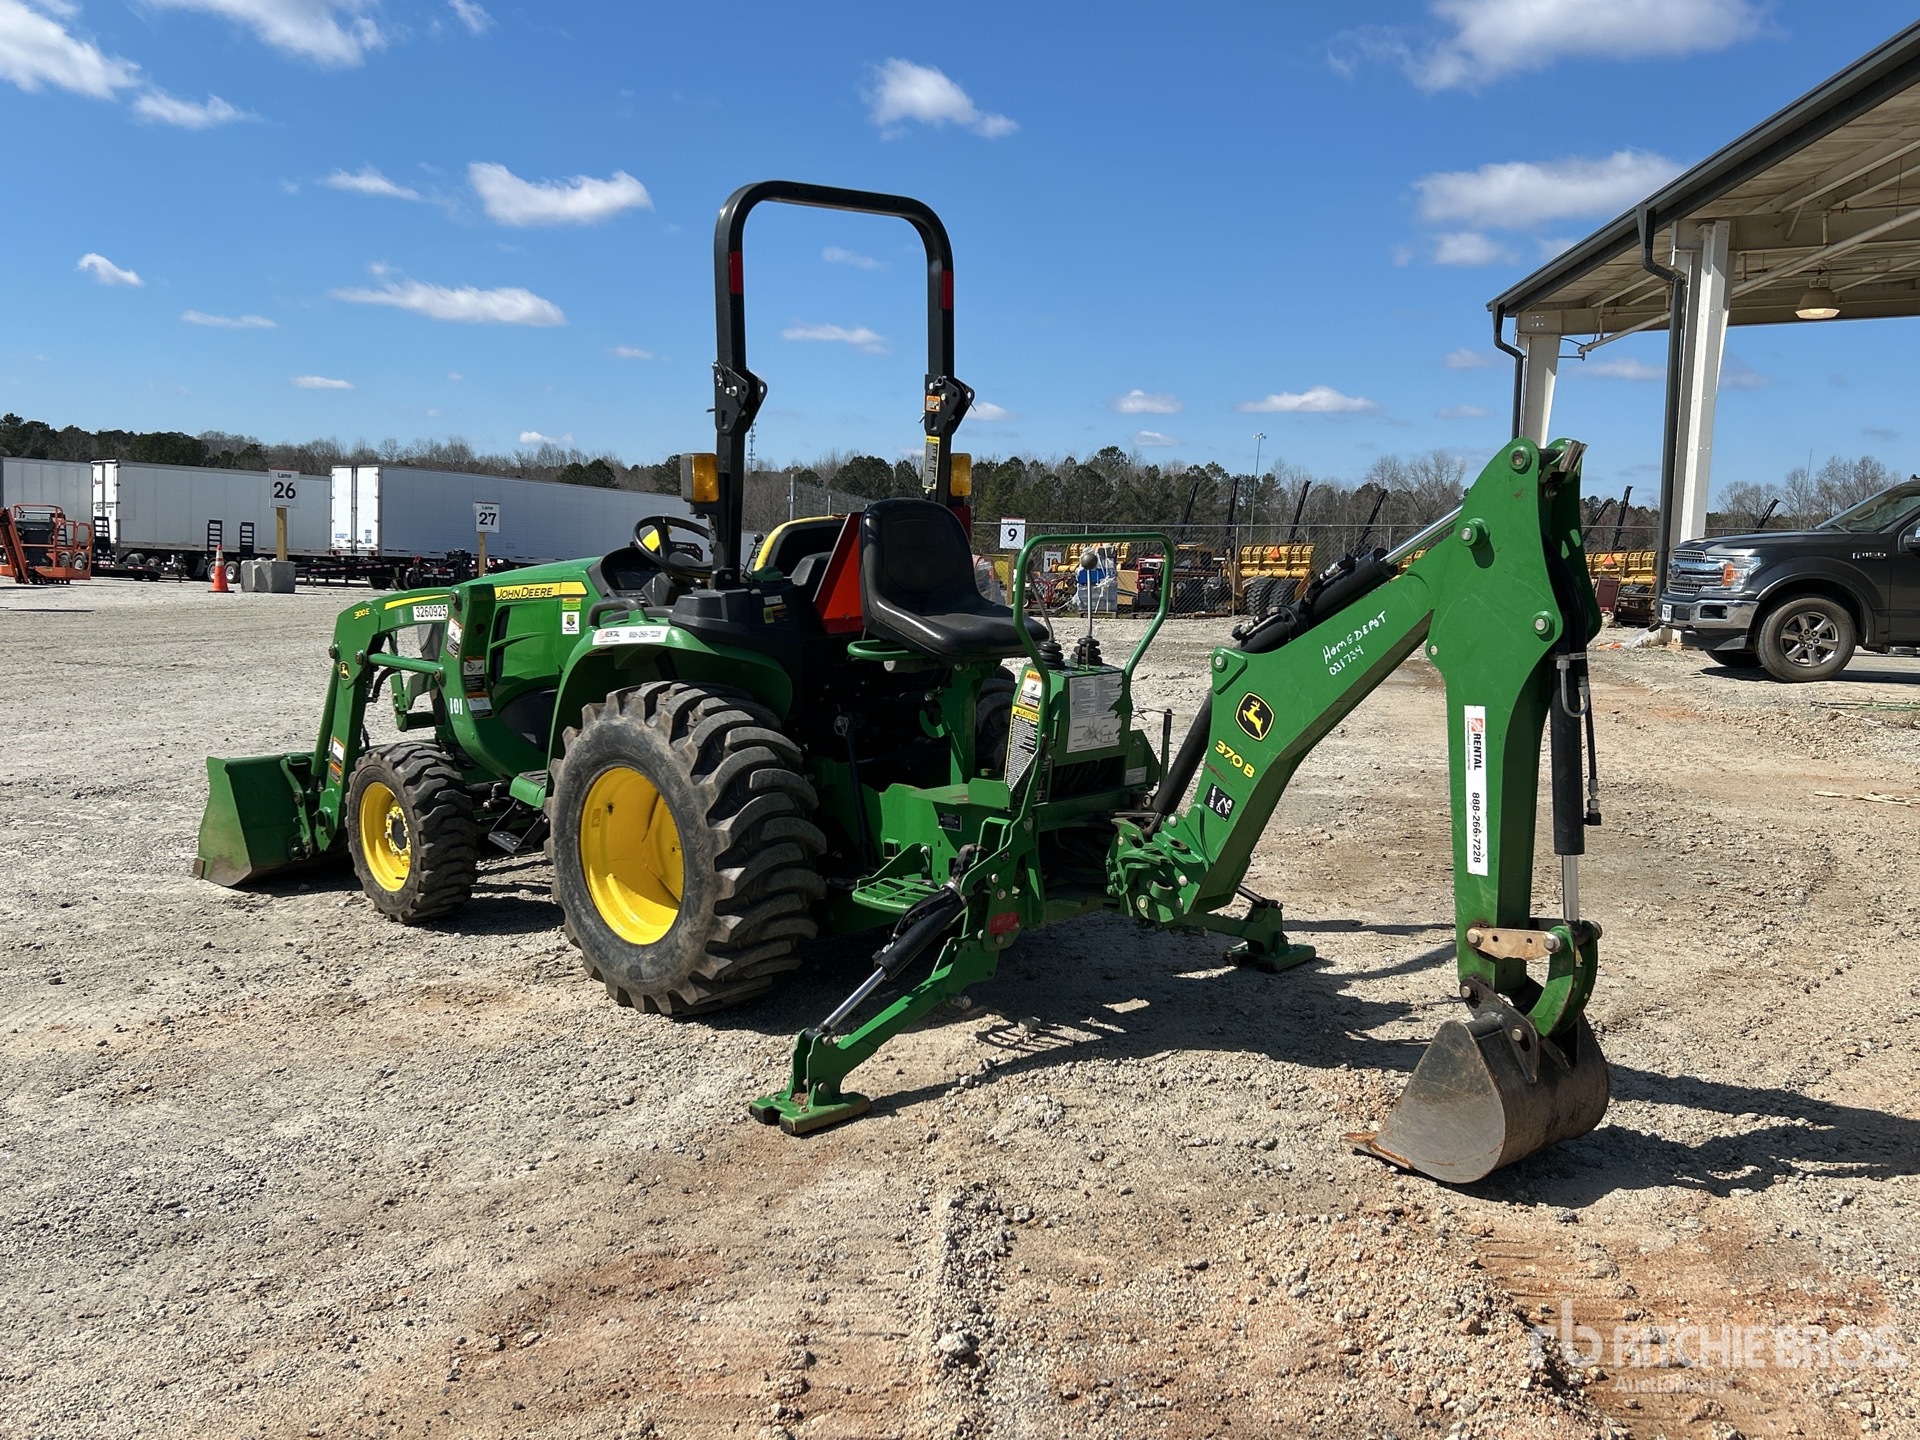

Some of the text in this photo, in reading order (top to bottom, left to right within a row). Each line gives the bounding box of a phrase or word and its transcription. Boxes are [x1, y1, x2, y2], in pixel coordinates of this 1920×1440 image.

[273, 481, 296, 500] 26
[478, 512, 497, 526] 27
[1008, 528, 1018, 542] 9
[495, 585, 554, 599] JOHN DEERE
[353, 608, 371, 620] 300E
[415, 605, 448, 618] 3260925
[1353, 610, 1386, 641] DEPOT
[1329, 645, 1364, 675] 031734
[449, 697, 464, 715] 101
[1214, 740, 1256, 779] 370 B
[1473, 733, 1483, 771] RENTAL
[1471, 792, 1482, 863] 888-266-7228
